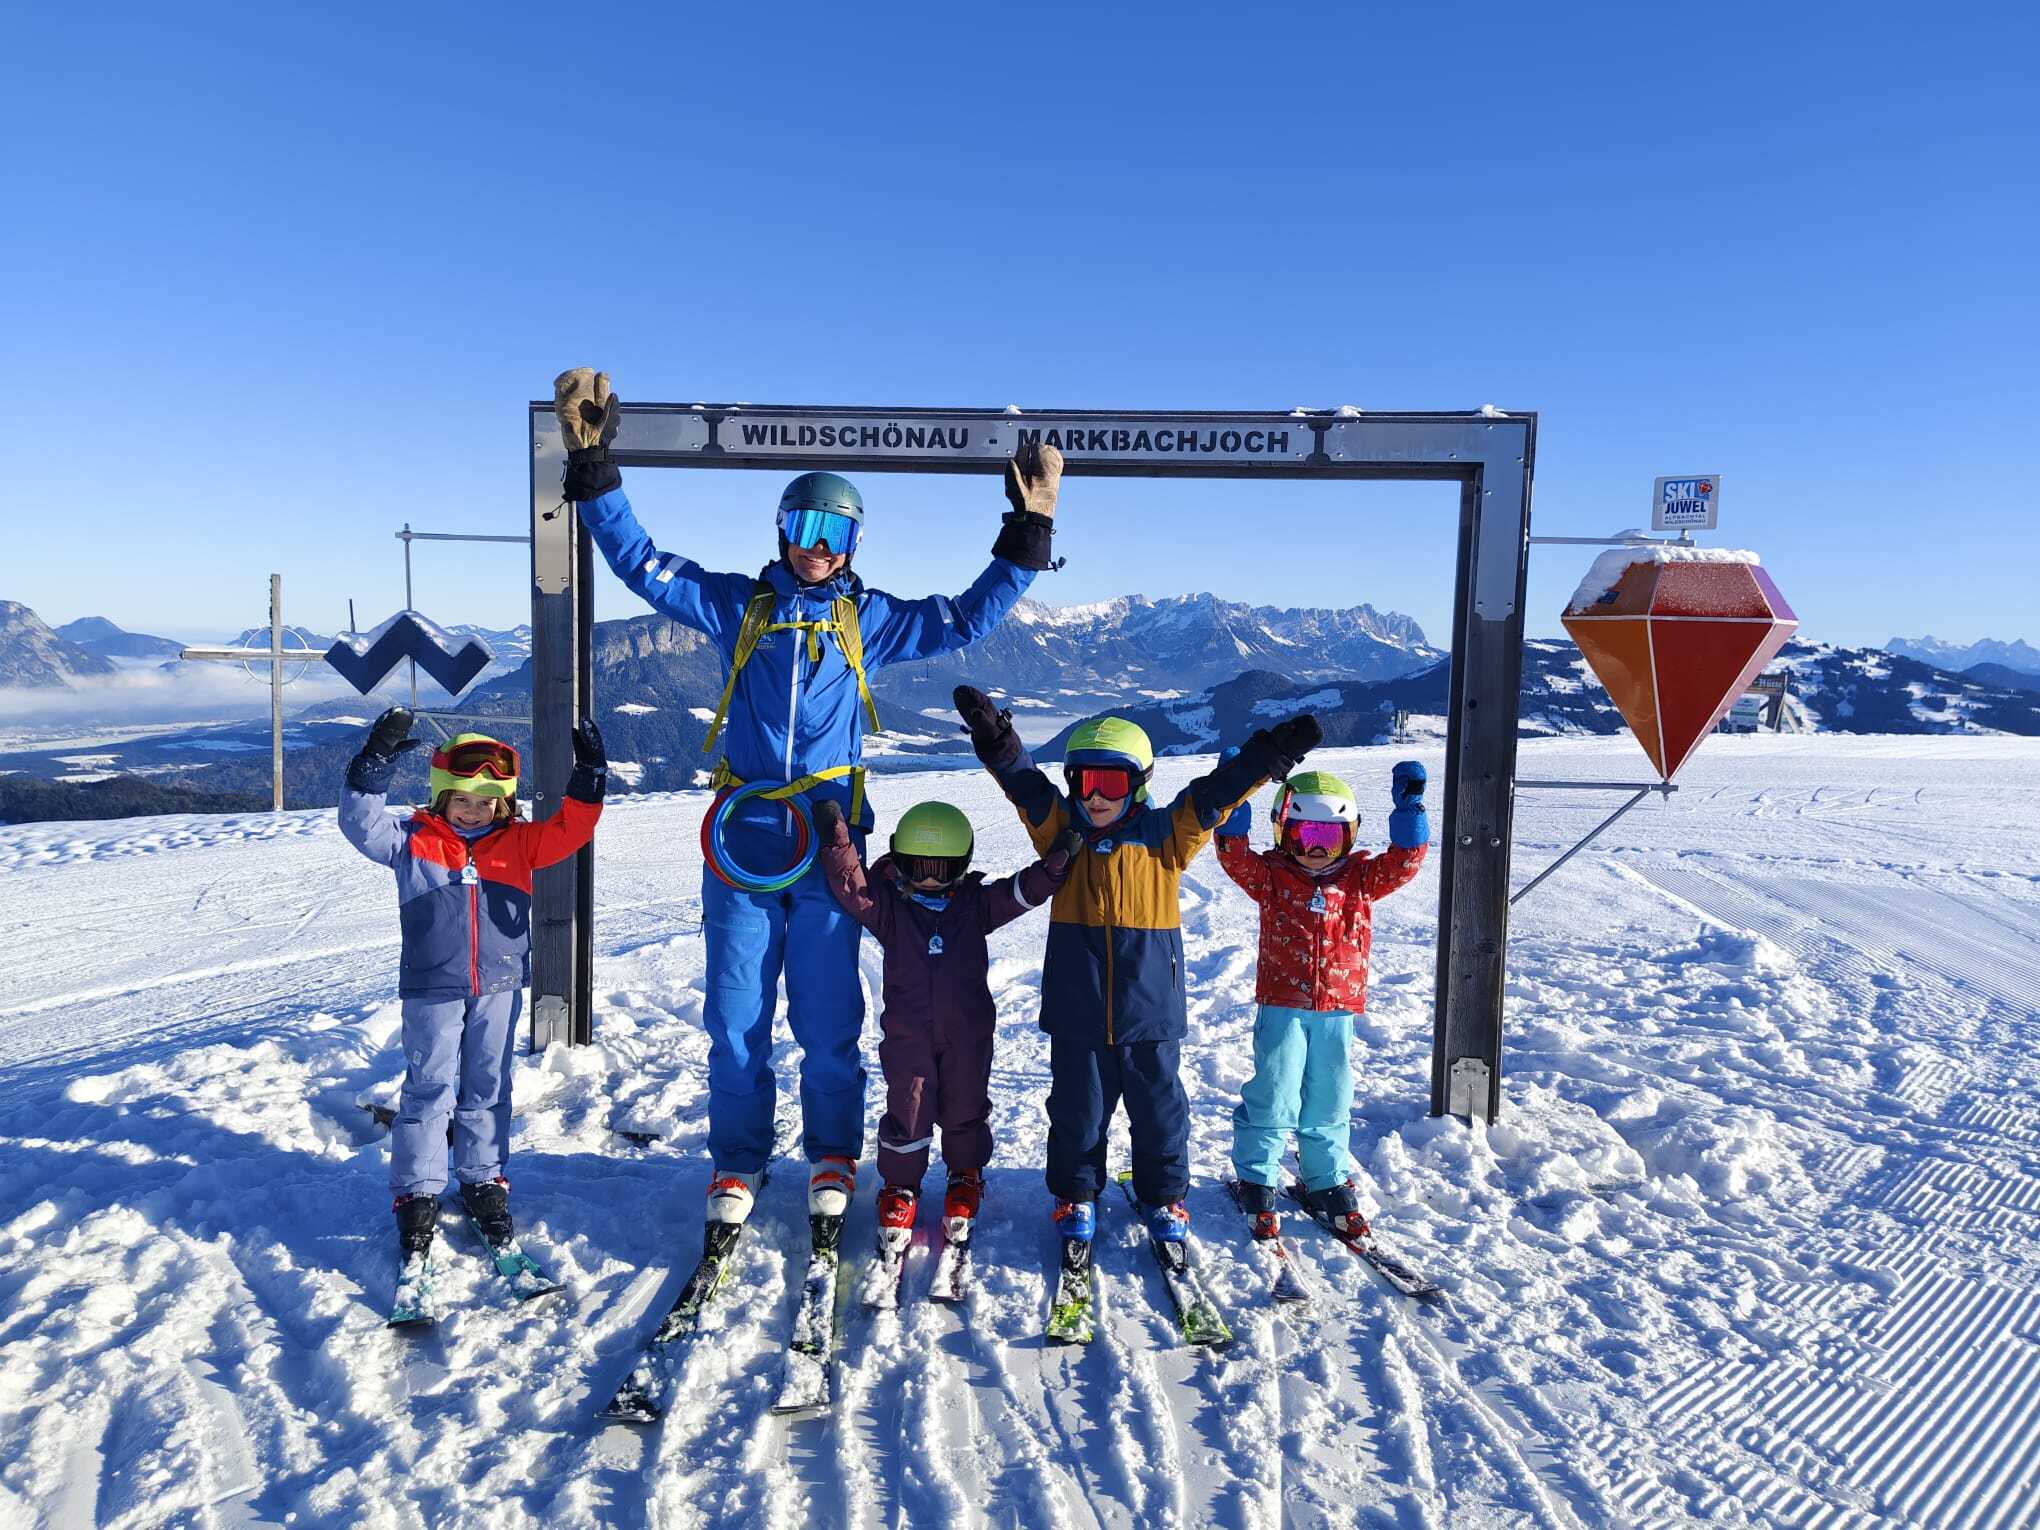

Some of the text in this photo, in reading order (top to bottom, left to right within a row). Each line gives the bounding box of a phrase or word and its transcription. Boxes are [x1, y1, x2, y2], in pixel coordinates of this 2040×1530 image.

[742, 423, 969, 449] WILDSCHÖNAU
[1017, 429, 1289, 453] MARKBACHJOCH
[1665, 482, 1696, 502] SKI
[1664, 500, 1706, 514] JUWEL
